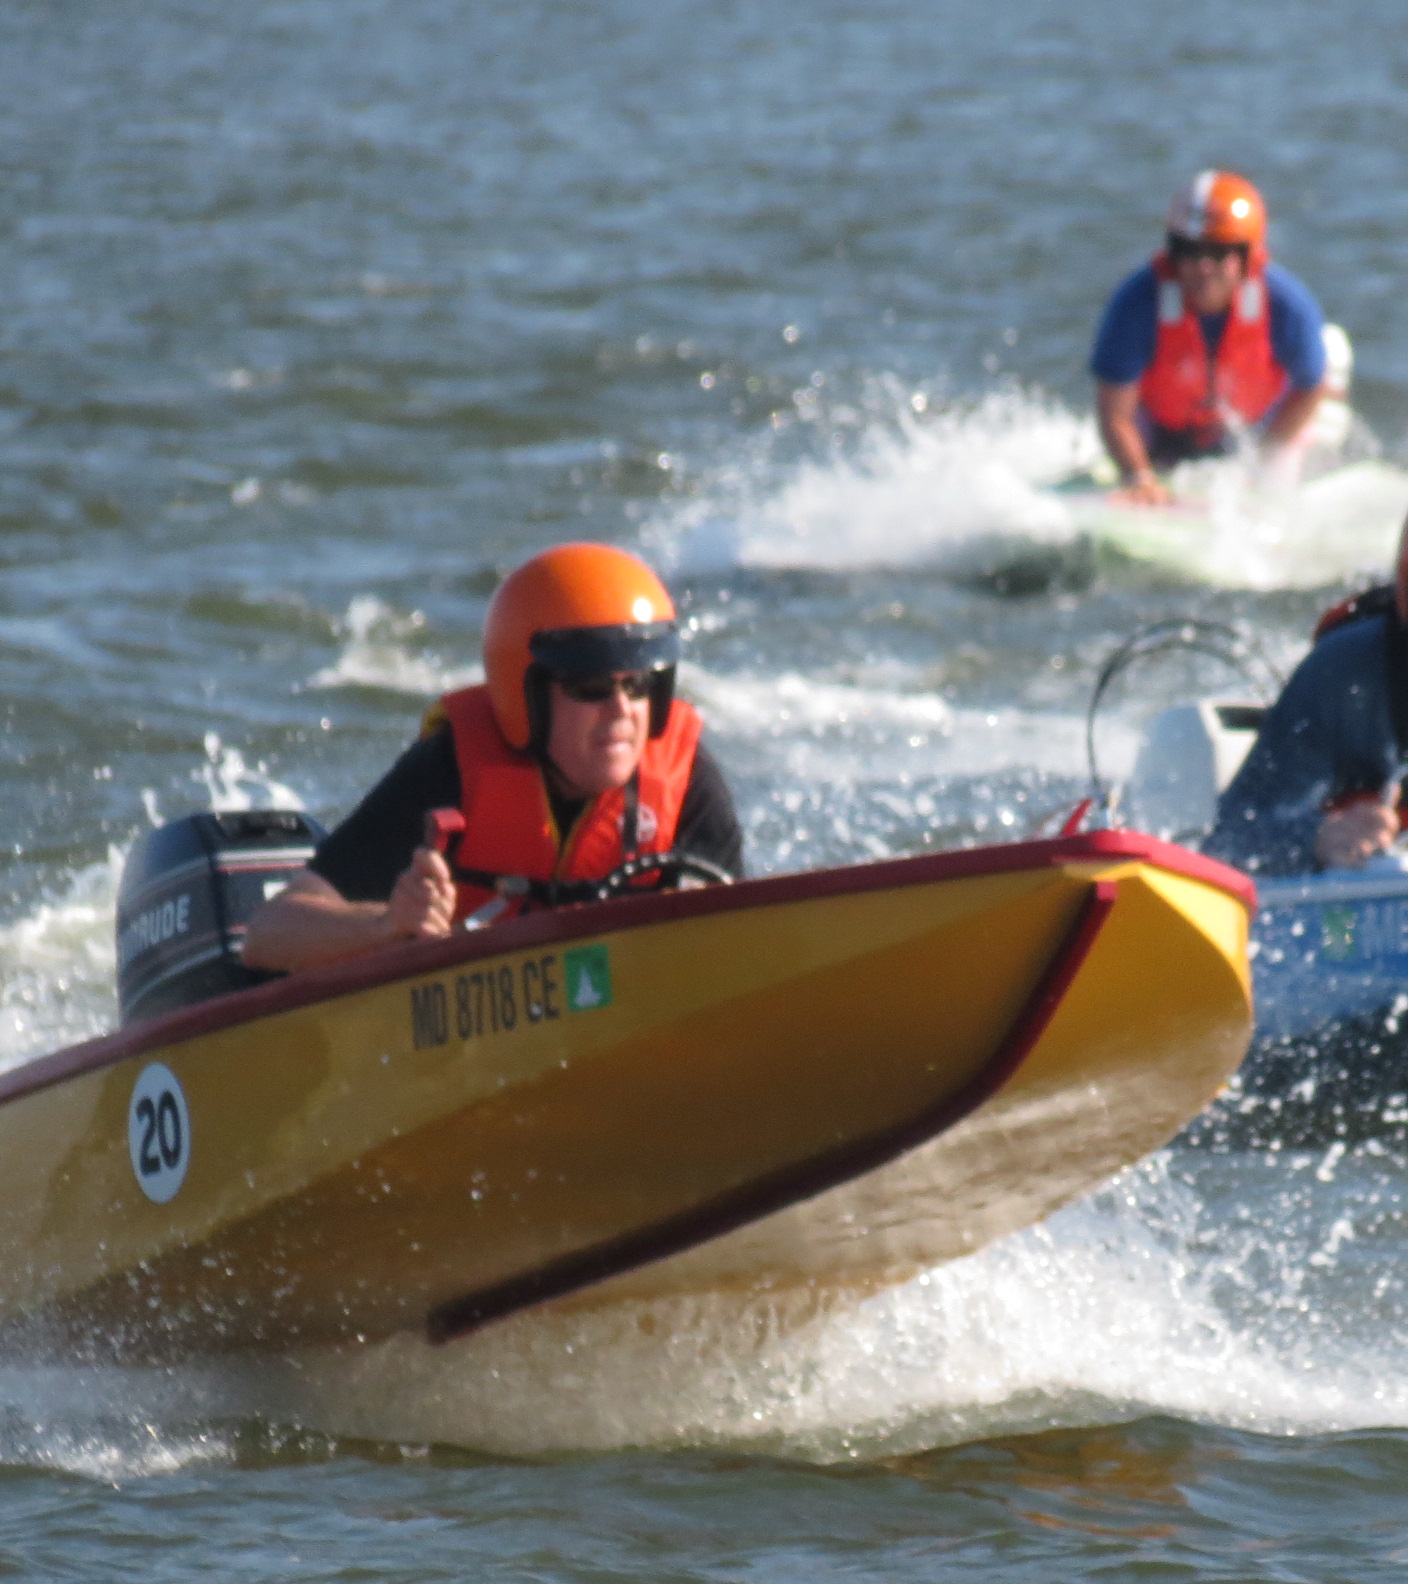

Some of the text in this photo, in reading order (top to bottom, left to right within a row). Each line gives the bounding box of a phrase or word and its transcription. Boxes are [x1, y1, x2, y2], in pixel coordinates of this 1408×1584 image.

[411, 954, 560, 1050] MD 8718 CE
[136, 1089, 182, 1177] 20
